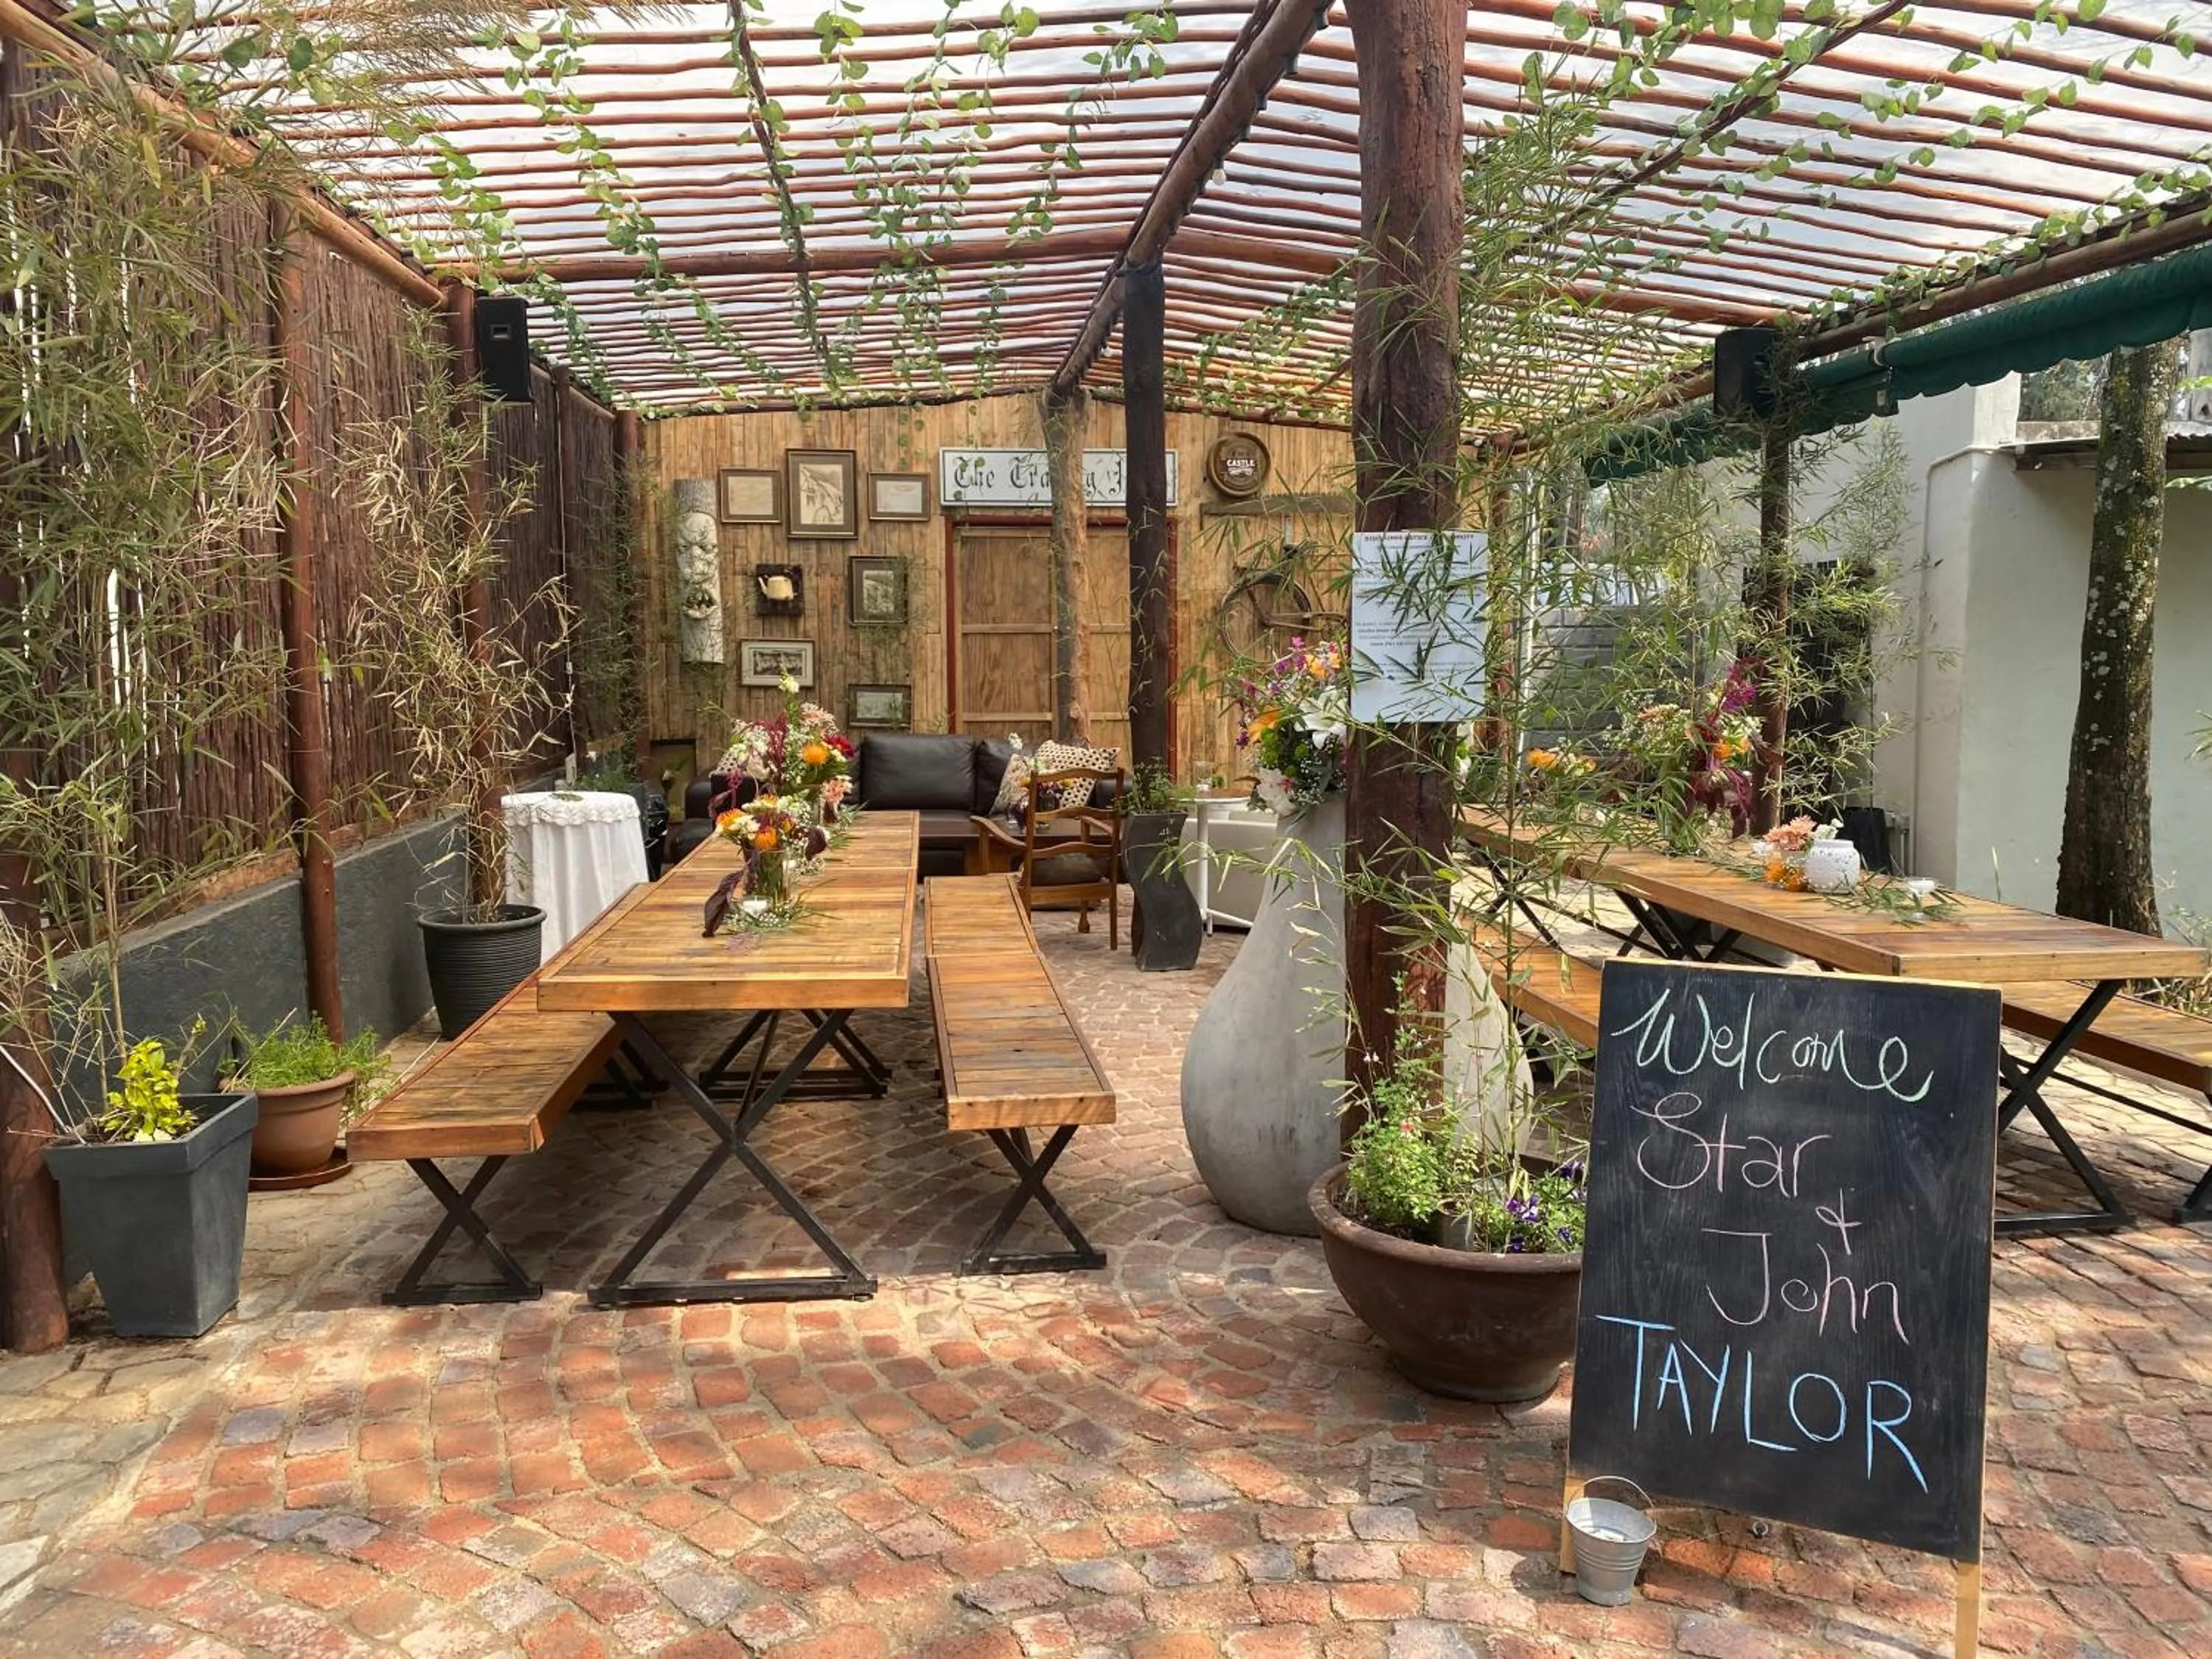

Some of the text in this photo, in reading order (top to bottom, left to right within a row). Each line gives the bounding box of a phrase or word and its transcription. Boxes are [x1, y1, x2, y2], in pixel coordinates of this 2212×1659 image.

[953, 455, 995, 490] The
[1612, 988, 1934, 1102] Welcome
[1630, 1091, 1833, 1197] Star
[1702, 1228, 1909, 1345] John
[1595, 1315, 1928, 1493] TAYLOR
